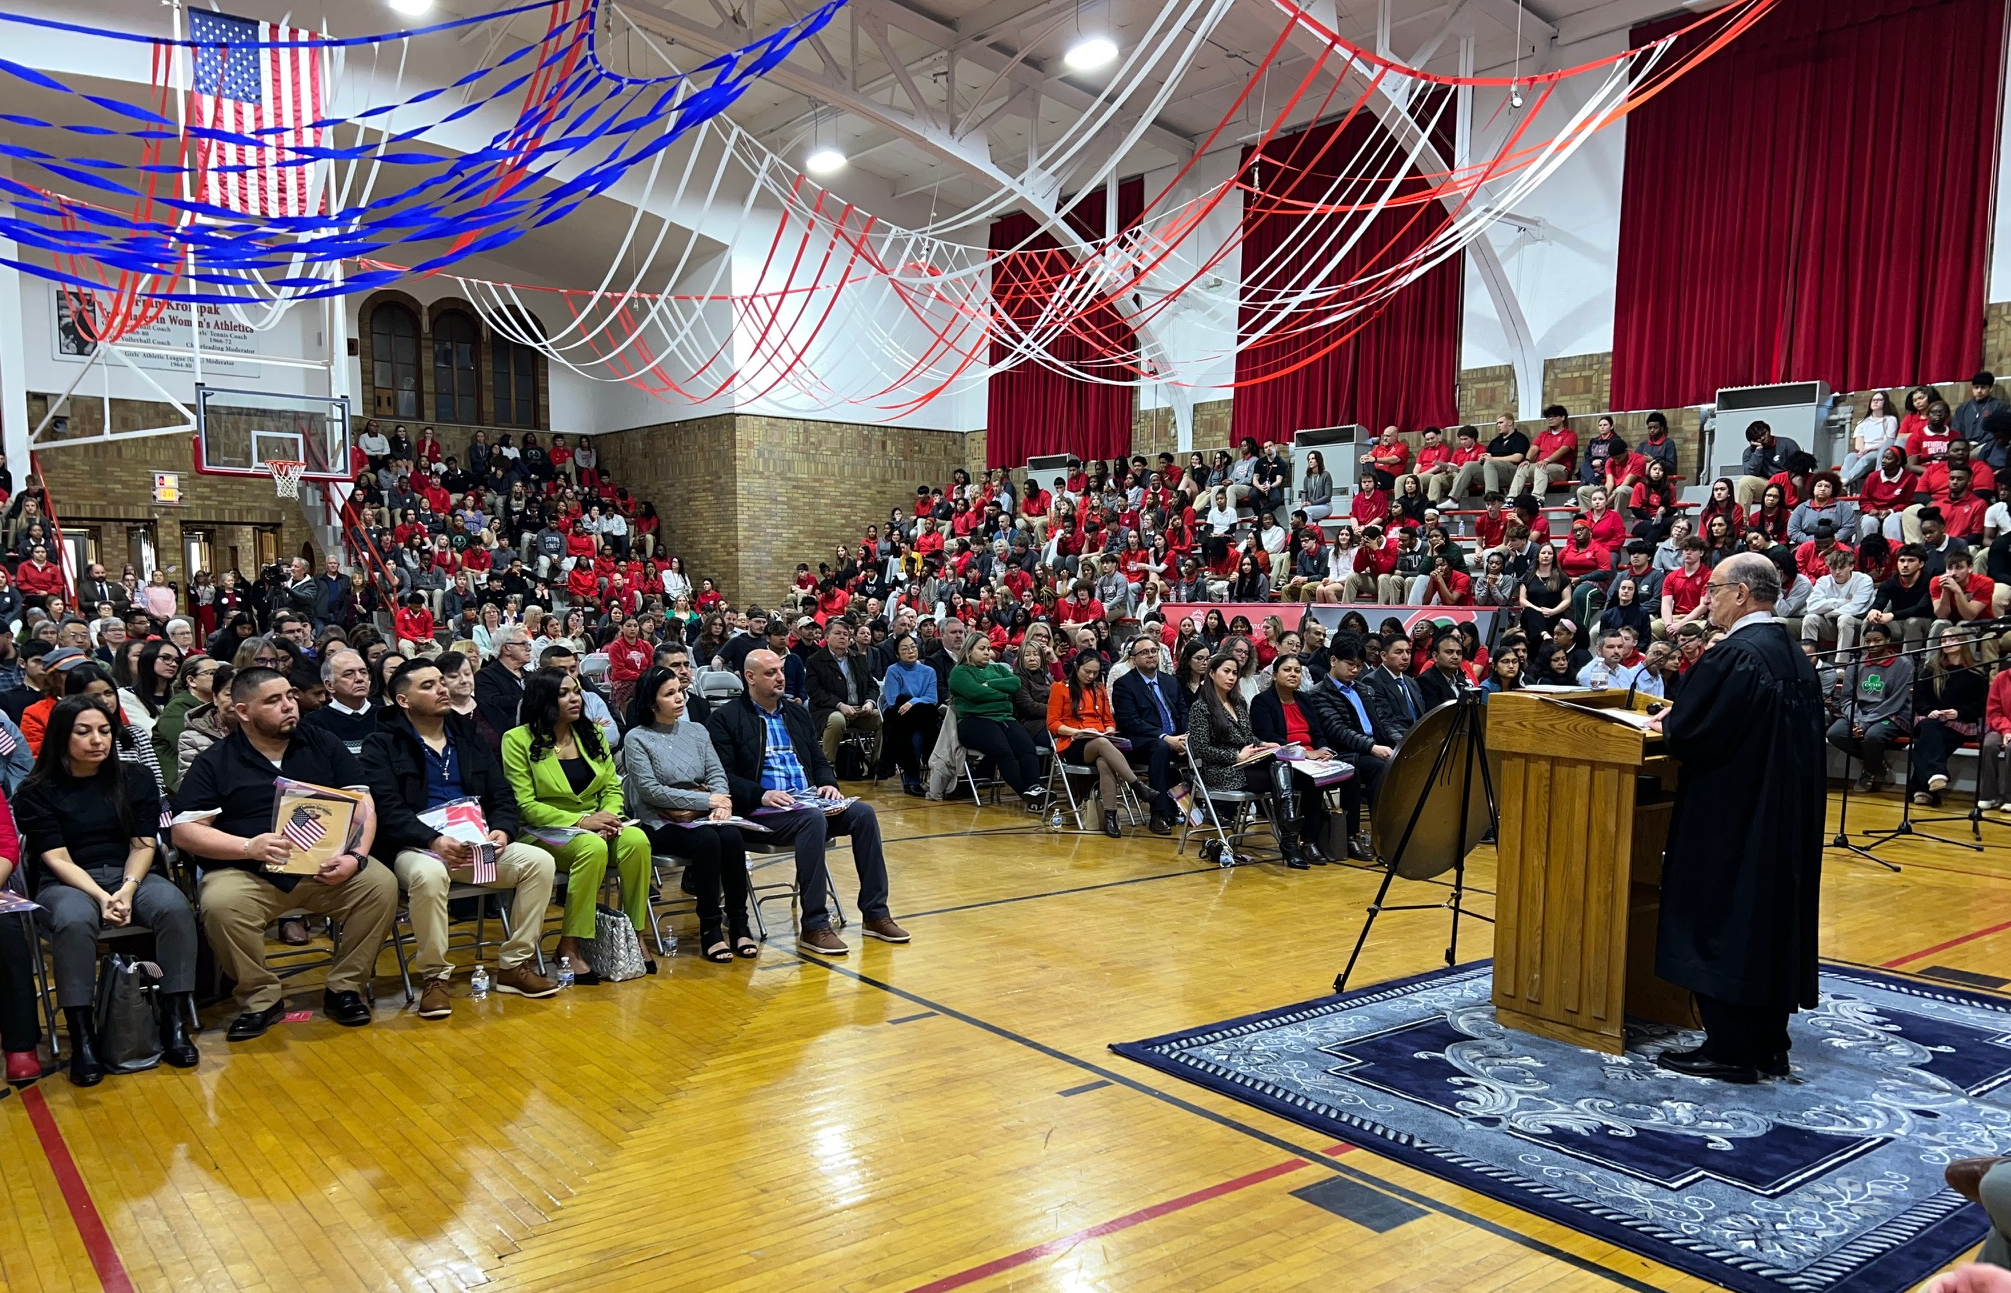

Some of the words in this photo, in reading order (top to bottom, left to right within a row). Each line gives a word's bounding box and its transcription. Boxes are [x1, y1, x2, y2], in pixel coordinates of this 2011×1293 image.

[168, 314, 211, 329] Womn's
[213, 319, 255, 334] Athletics
[152, 338, 171, 347] Coach
[185, 341, 225, 352] Chrleading
[225, 345, 255, 354] Moderator
[142, 352, 165, 360] Athletic
[206, 357, 235, 366] Moderator
